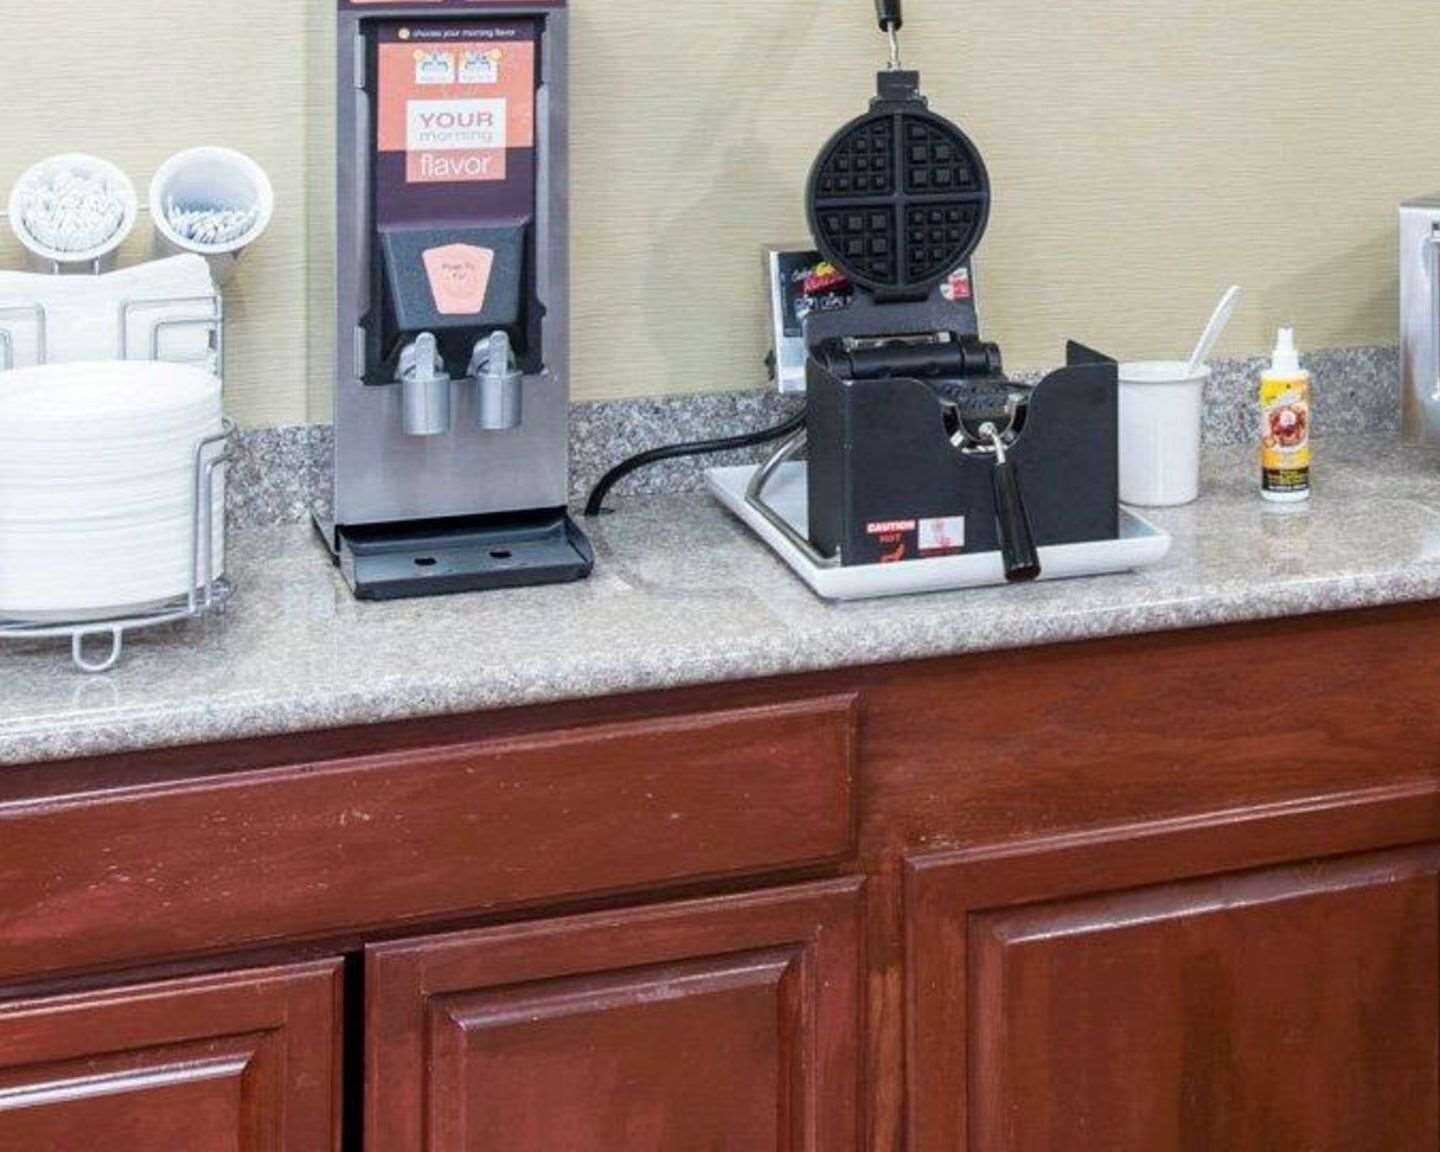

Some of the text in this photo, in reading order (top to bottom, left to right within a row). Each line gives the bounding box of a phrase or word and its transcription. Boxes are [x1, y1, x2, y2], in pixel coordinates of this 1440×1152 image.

[420, 111, 494, 129] YOUR
[419, 129, 494, 144] morning
[420, 152, 494, 177] flavor
[867, 520, 916, 533] CAUTION
